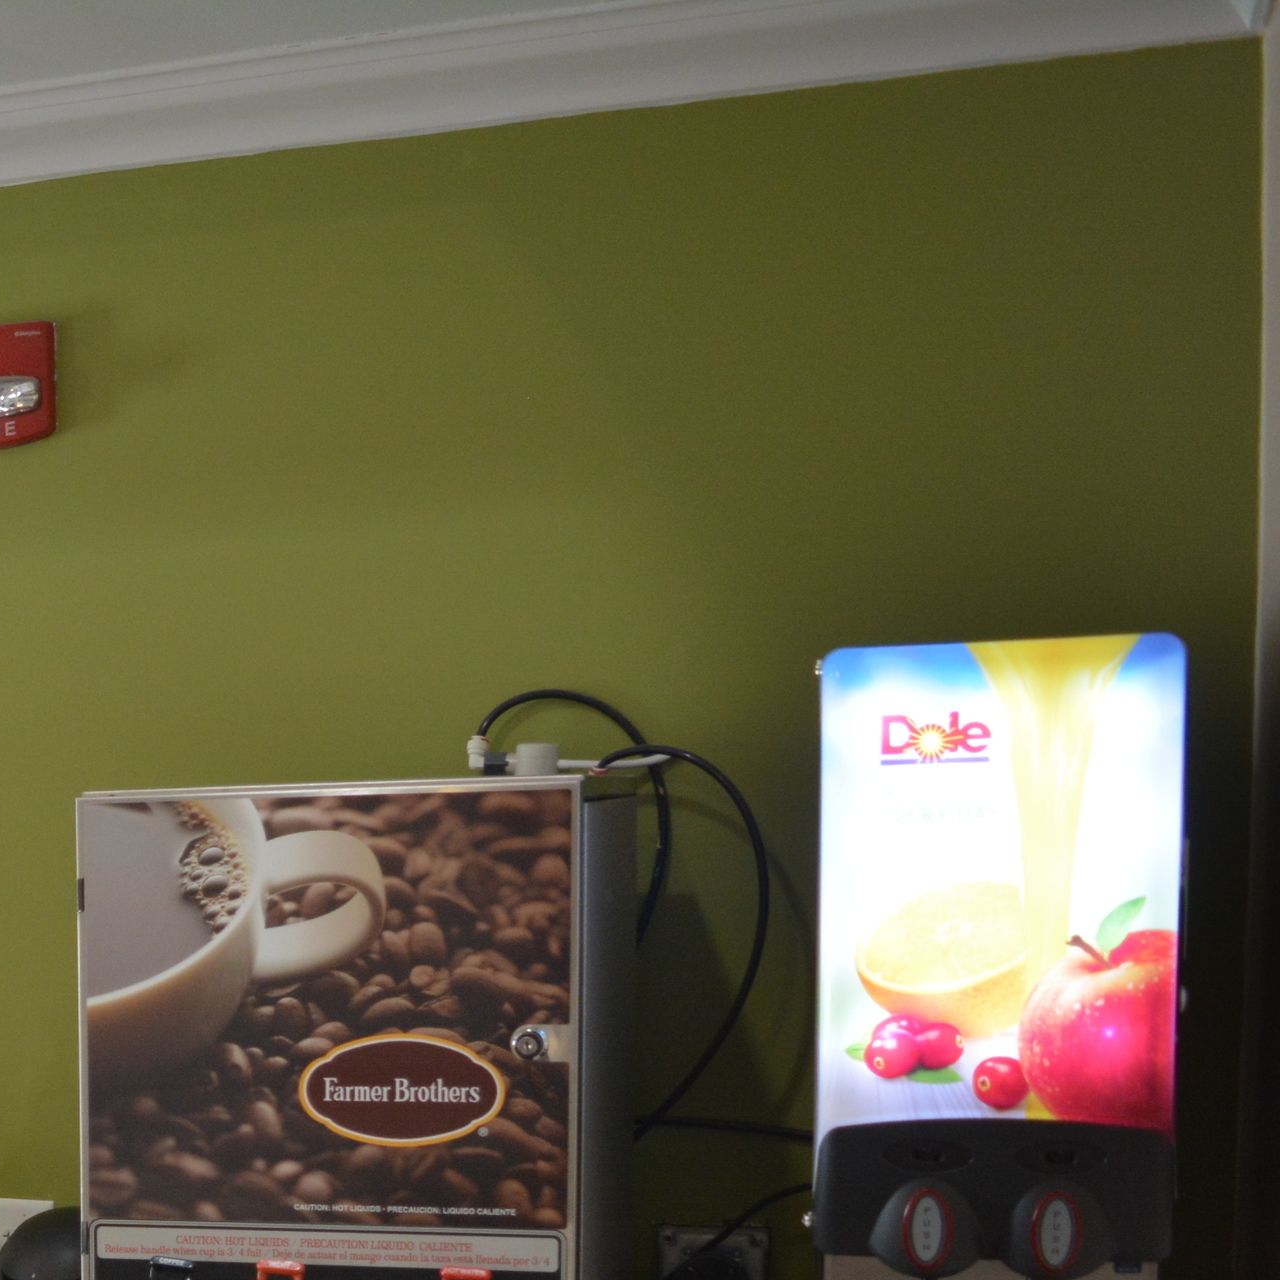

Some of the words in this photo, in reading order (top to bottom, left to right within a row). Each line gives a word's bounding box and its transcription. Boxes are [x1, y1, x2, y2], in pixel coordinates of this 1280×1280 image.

[880, 711, 992, 759] Dole
[322, 1076, 392, 1102] Farmer
[393, 1077, 481, 1103] Brothers
[293, 1203, 330, 1212] CAUTION:
[332, 1204, 349, 1212] HOT
[349, 1205, 382, 1213] LIQUIDS
[477, 1208, 517, 1217] CALIENTE
[104, 1243, 140, 1255] Release
[140, 1244, 172, 1256] handle
[172, 1246, 198, 1256] when
[199, 1248, 216, 1258] cup
[217, 1247, 225, 1257] is
[272, 1249, 293, 1261] Deje
[294, 1249, 306, 1259] de
[338, 1250, 348, 1260] el
[350, 1252, 382, 1264] mango
[384, 1252, 418, 1262] cuando
[513, 1257, 530, 1267] por
[175, 1235, 220, 1246] CAUTION:
[224, 1236, 246, 1247] HOT
[247, 1237, 289, 1248] LIQUIDS
[418, 1242, 473, 1253] CALIENTE
